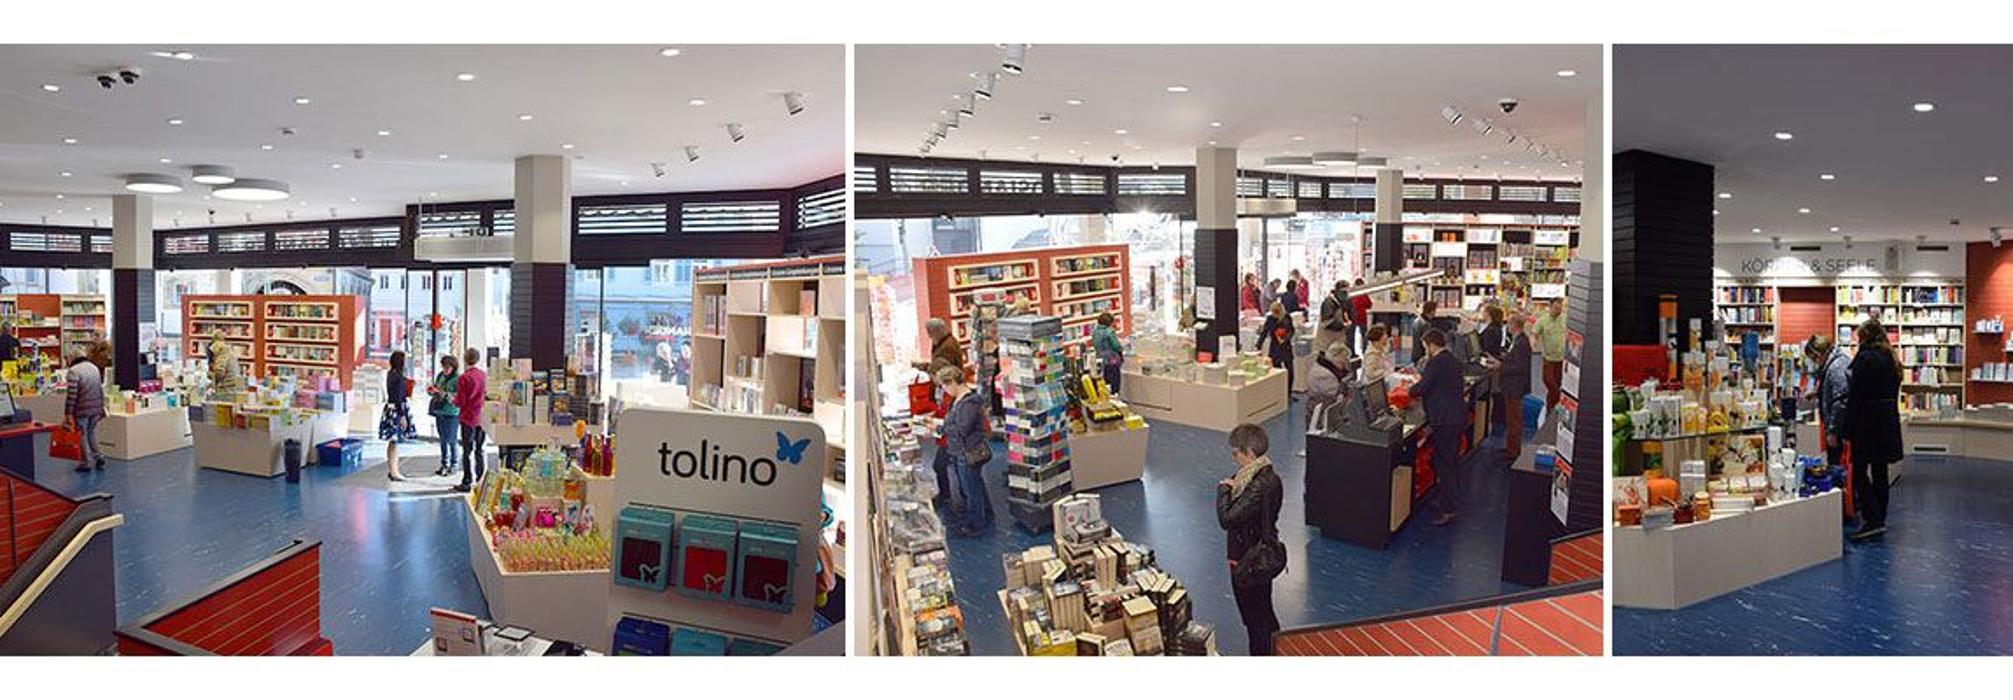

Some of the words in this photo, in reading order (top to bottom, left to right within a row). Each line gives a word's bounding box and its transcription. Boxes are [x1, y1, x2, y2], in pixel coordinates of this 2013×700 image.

[1741, 257, 1808, 273] KÖR
[1810, 259, 1821, 273] &
[658, 439, 777, 486] tolino
